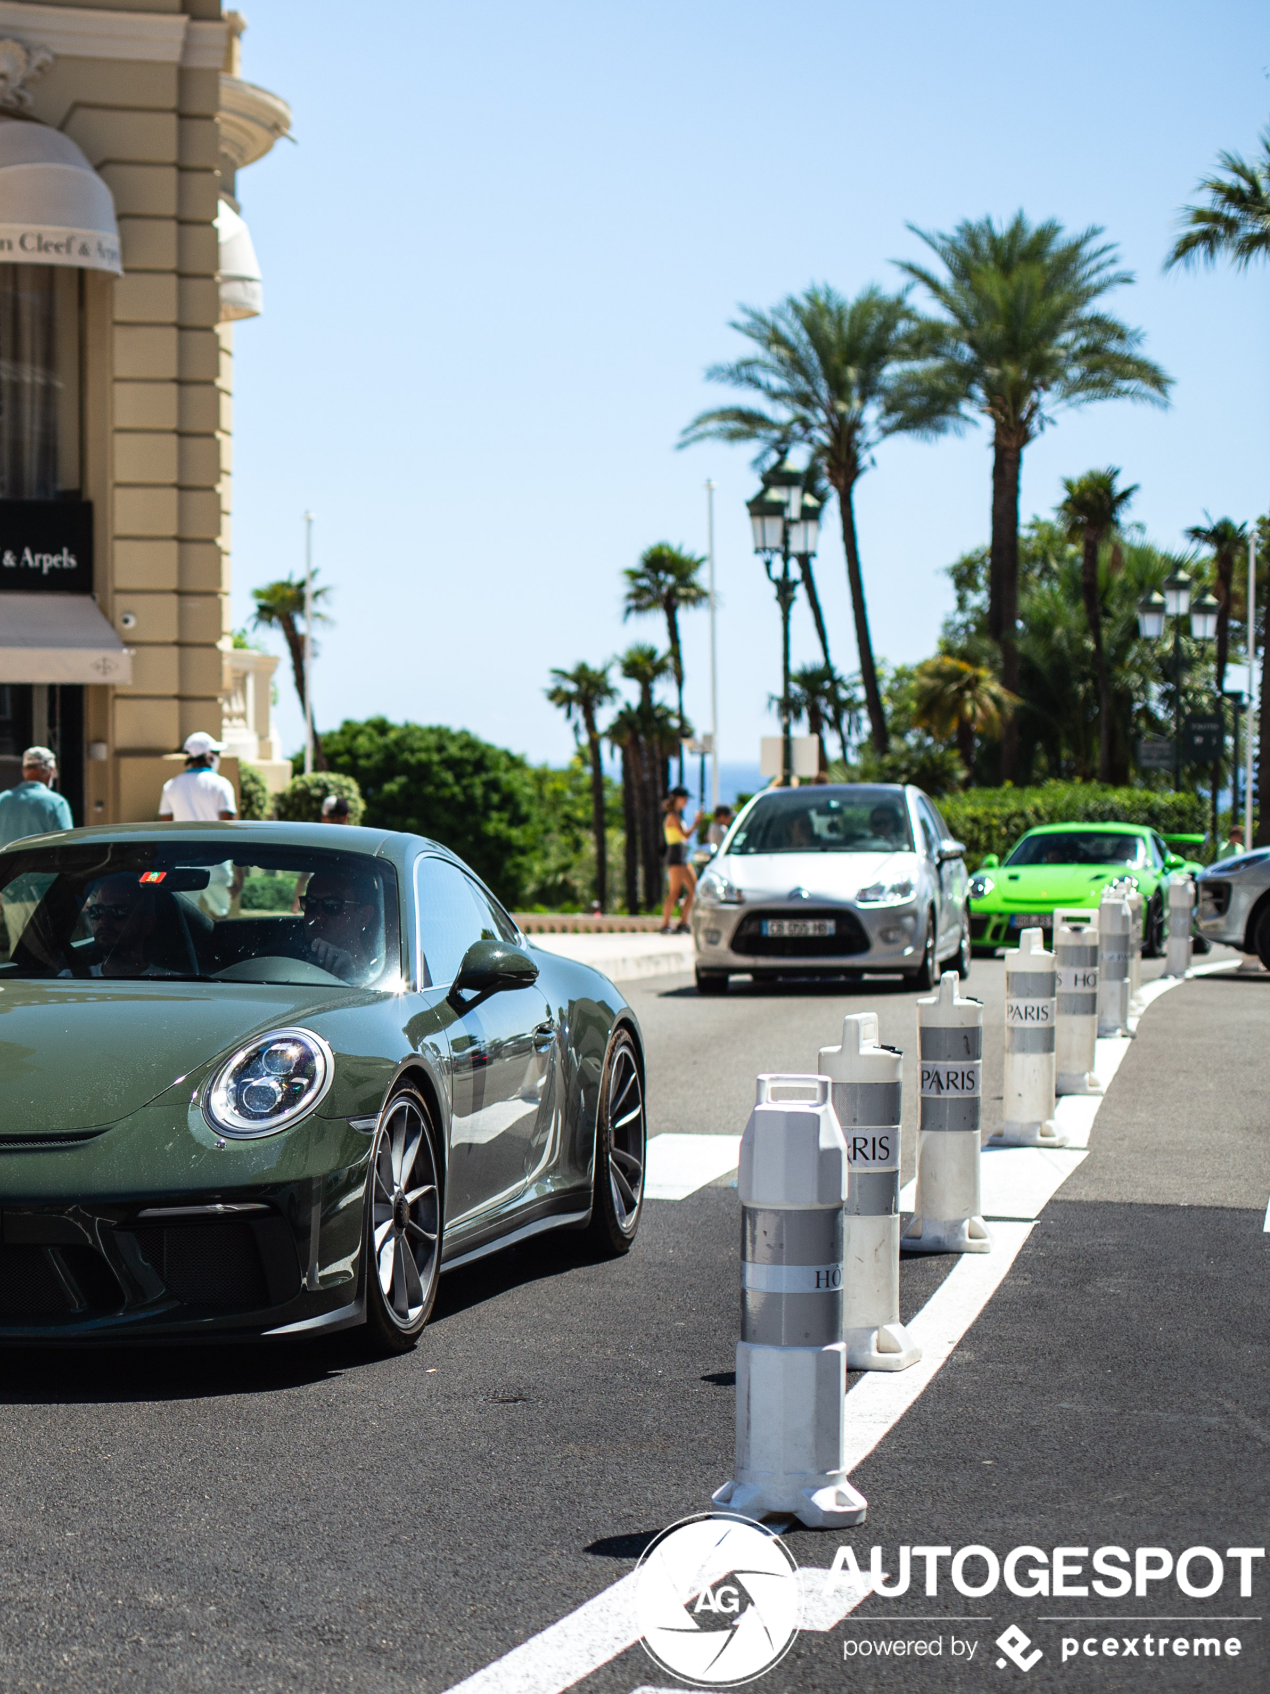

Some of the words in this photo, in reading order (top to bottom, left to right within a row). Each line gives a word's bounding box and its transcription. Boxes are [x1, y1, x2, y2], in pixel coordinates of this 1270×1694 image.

[18, 231, 76, 255] Cleef
[2, 550, 17, 568] &
[20, 546, 77, 575] Arpels
[1007, 1004, 1049, 1021] PARIS
[921, 1070, 975, 1090] PARIS
[848, 1135, 890, 1162] RIS
